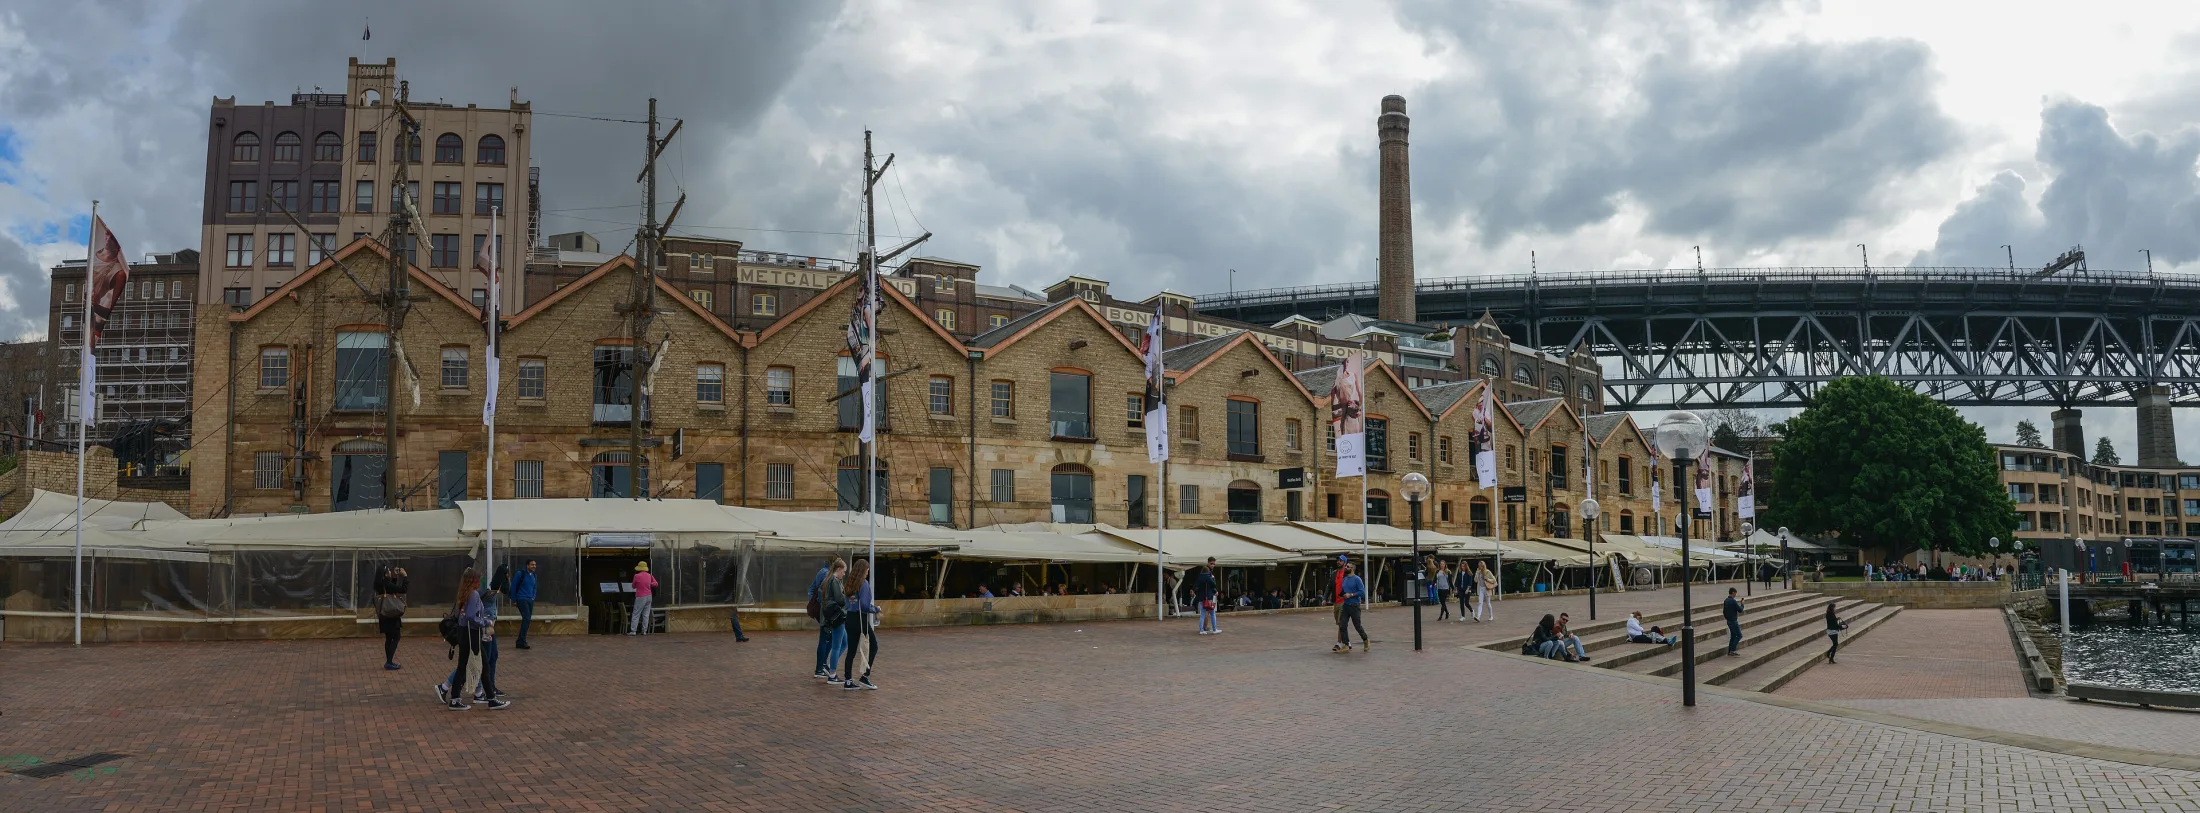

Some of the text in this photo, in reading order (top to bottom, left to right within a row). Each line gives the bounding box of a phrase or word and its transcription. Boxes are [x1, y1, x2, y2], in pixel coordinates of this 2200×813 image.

[741, 269, 845, 288] METCALF
[1110, 309, 1154, 324] BON
[1197, 323, 1294, 349] METLFE
